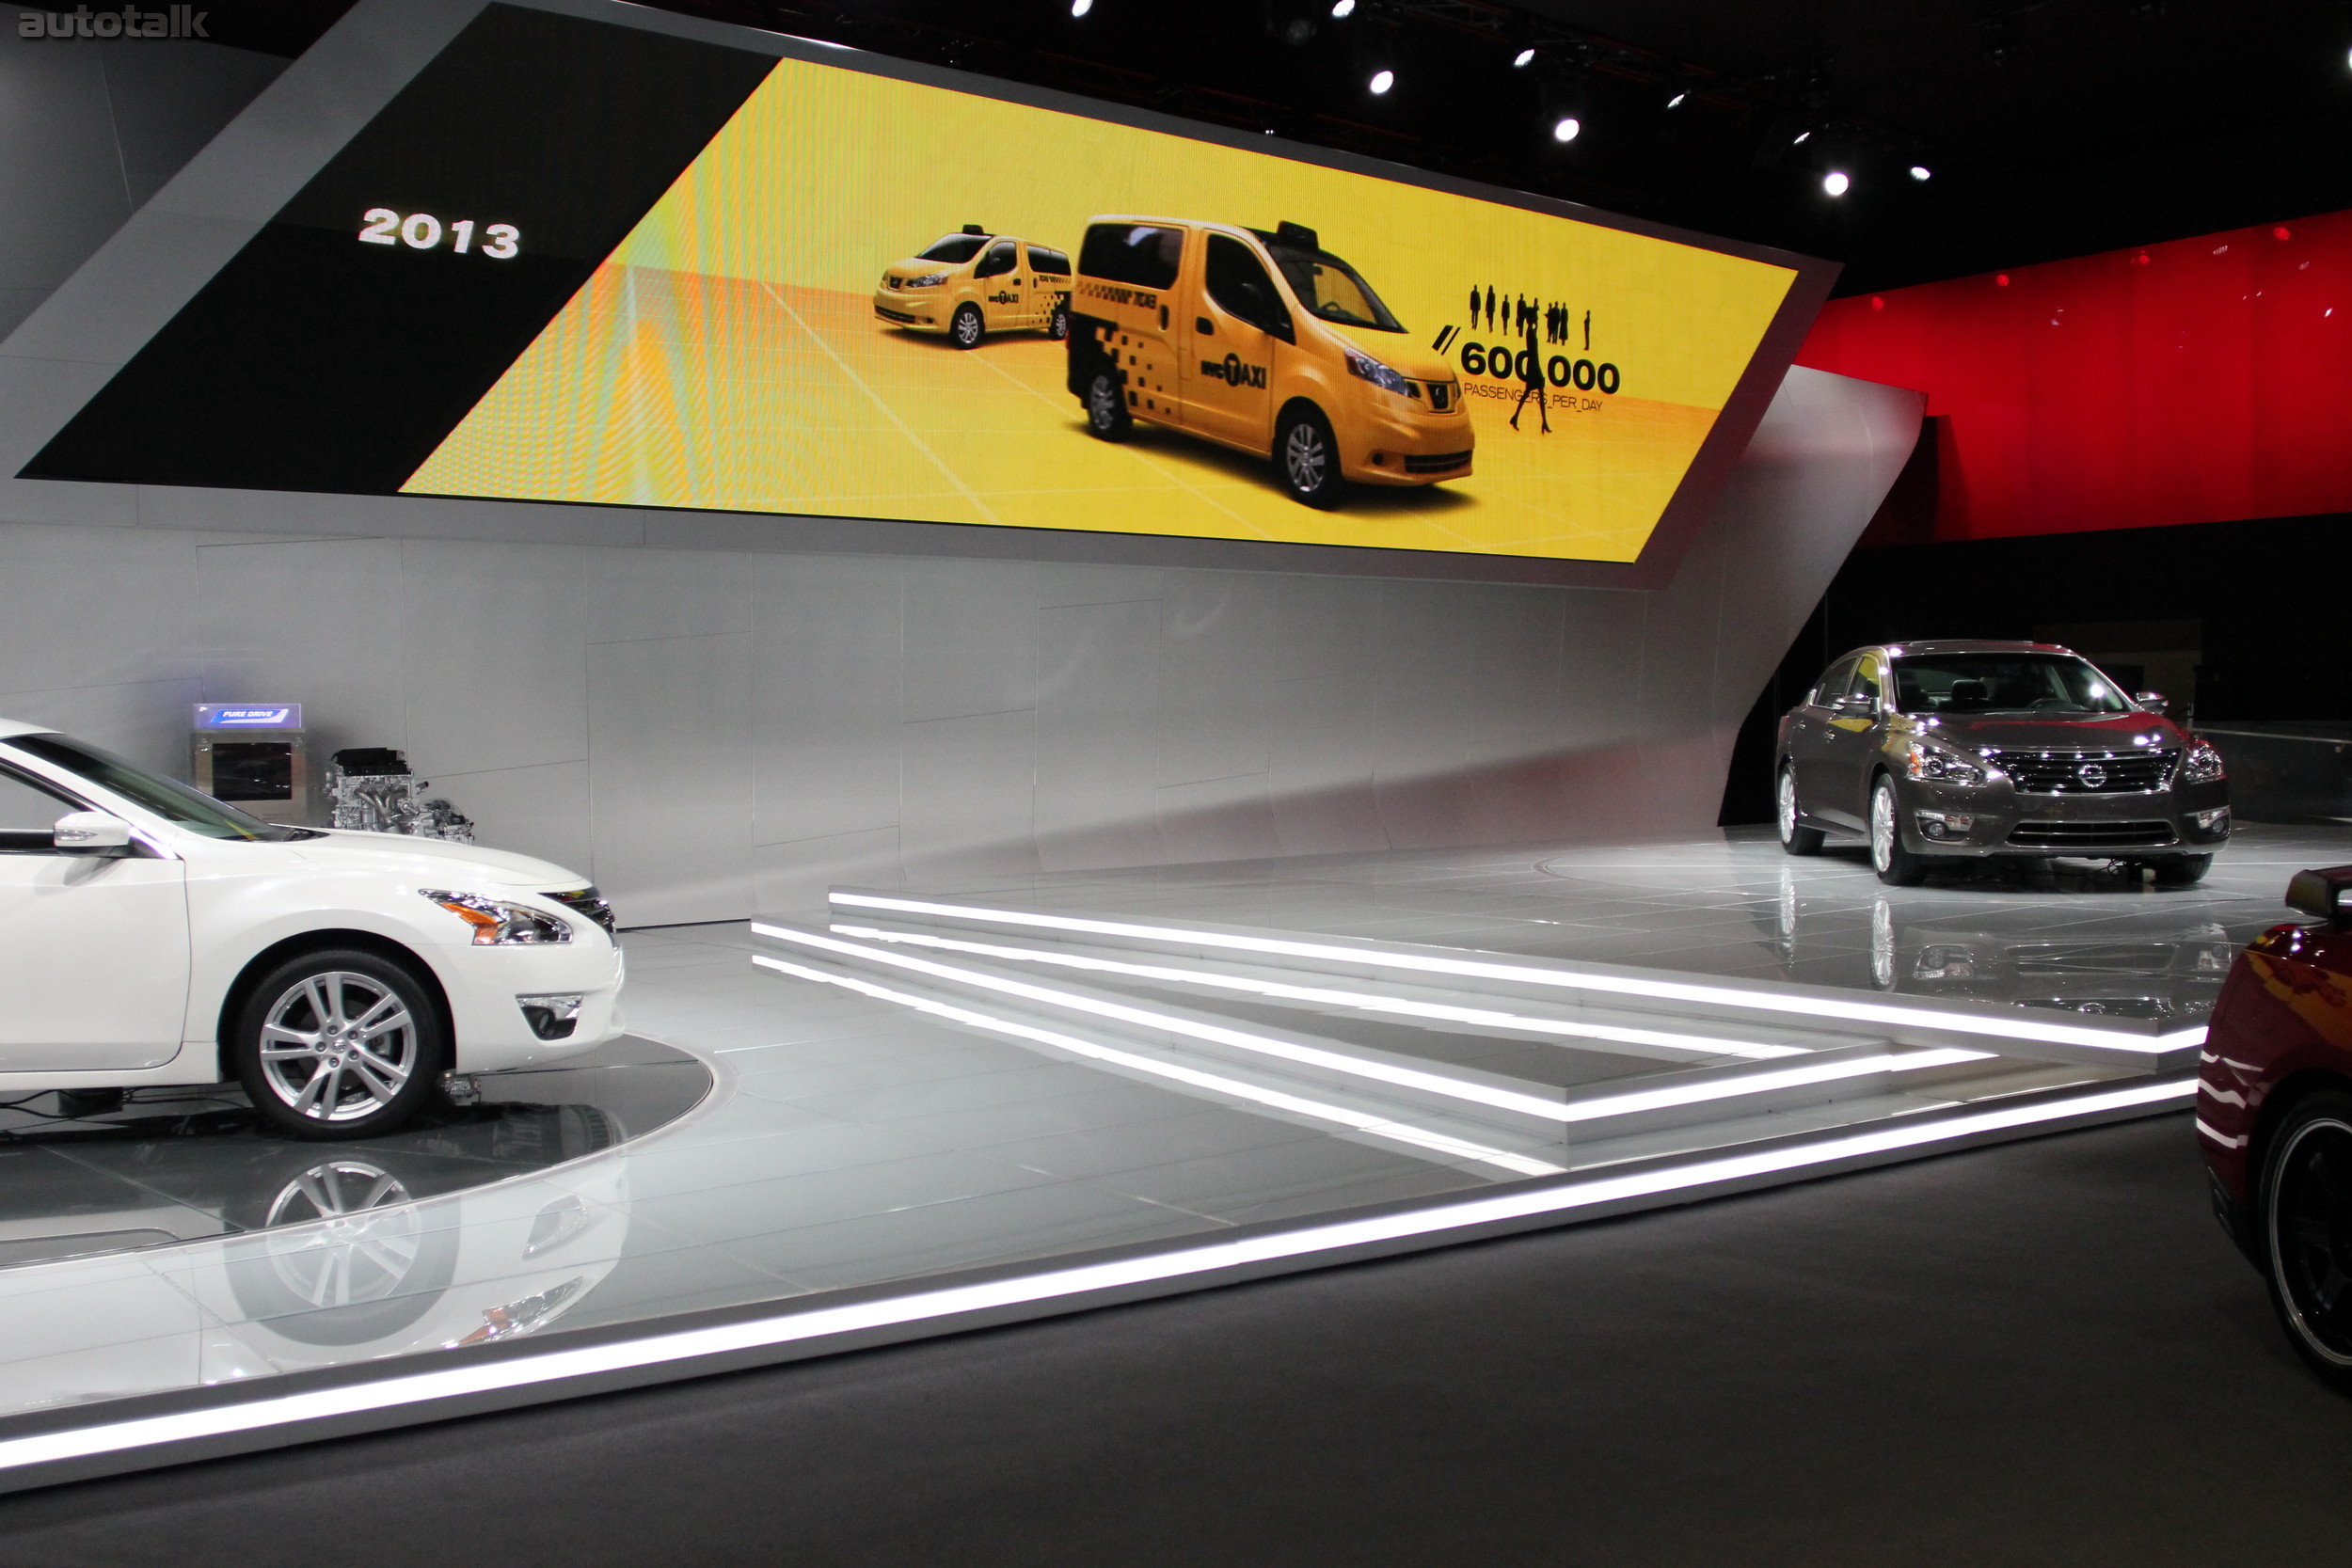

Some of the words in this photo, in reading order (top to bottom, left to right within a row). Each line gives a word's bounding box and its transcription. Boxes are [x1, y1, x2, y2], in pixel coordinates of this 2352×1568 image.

[358, 207, 520, 260] 2013
[1225, 353, 1266, 389] TAXI
[1460, 341, 1621, 395] 600000
